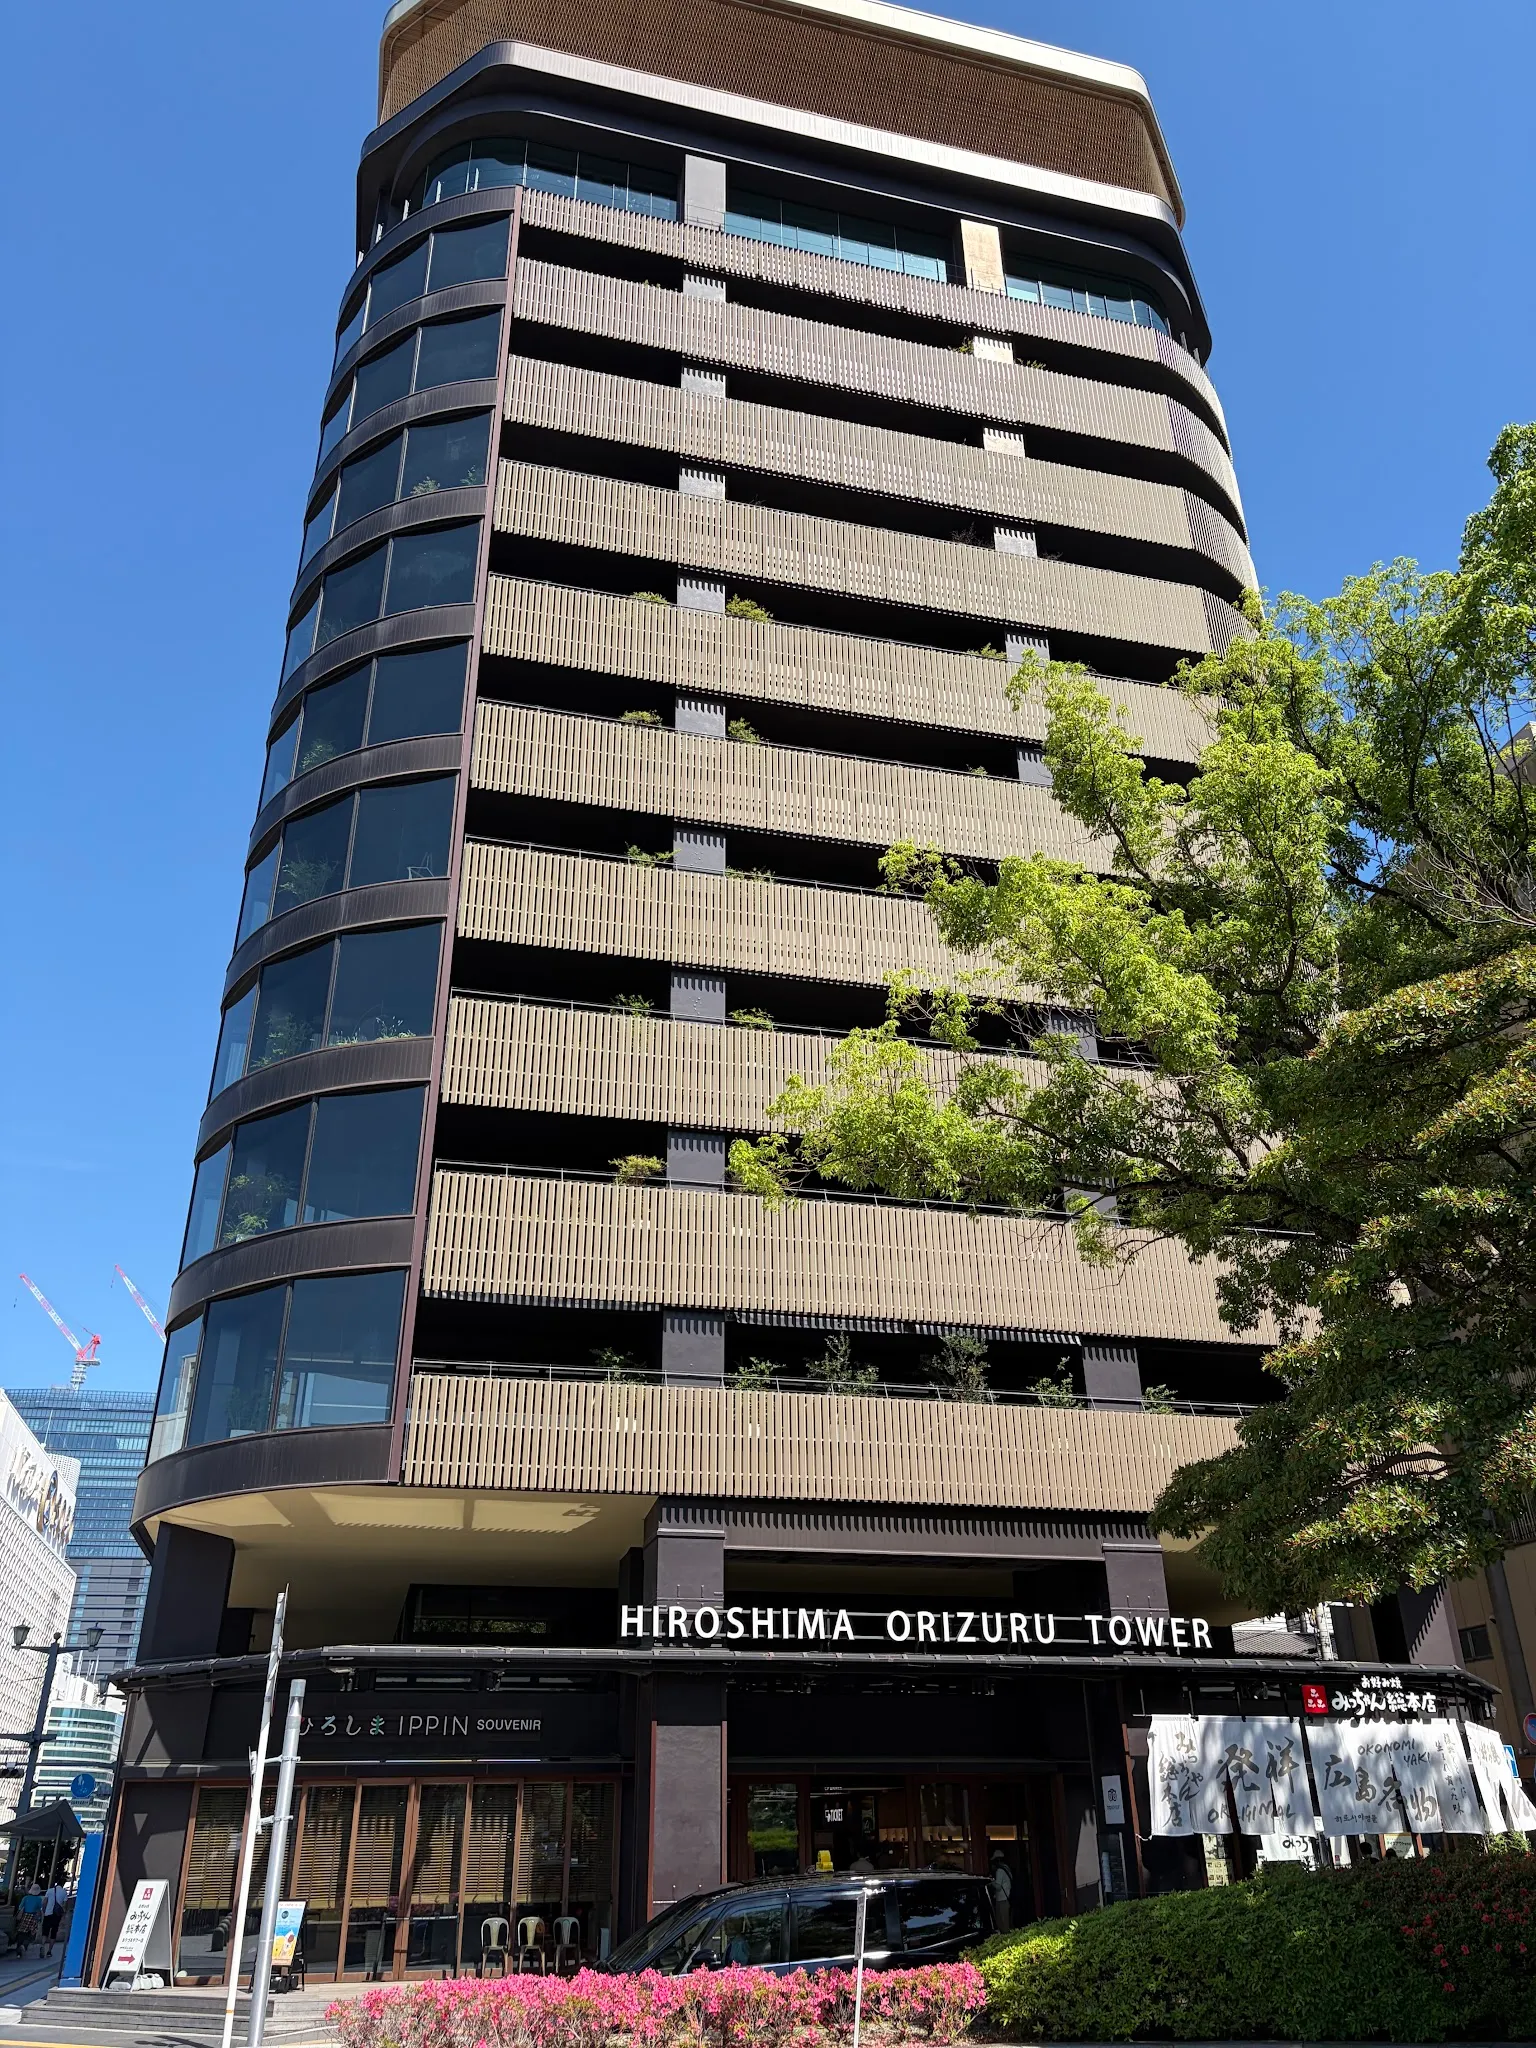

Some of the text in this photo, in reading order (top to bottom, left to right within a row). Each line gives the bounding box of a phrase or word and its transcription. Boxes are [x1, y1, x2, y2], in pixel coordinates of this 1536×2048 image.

[620, 1605, 1213, 1648] HIROSHIMA ORIZURU TOWER
[1361, 1675, 1403, 1689] お好み焼
[1331, 1688, 1437, 1715] みっちゃん総本店
[398, 1716, 469, 1736] IPPIN
[476, 1719, 542, 1731] SOUVENIR
[1357, 1738, 1416, 1756] OKONOMI
[1403, 1752, 1431, 1767] YAKI
